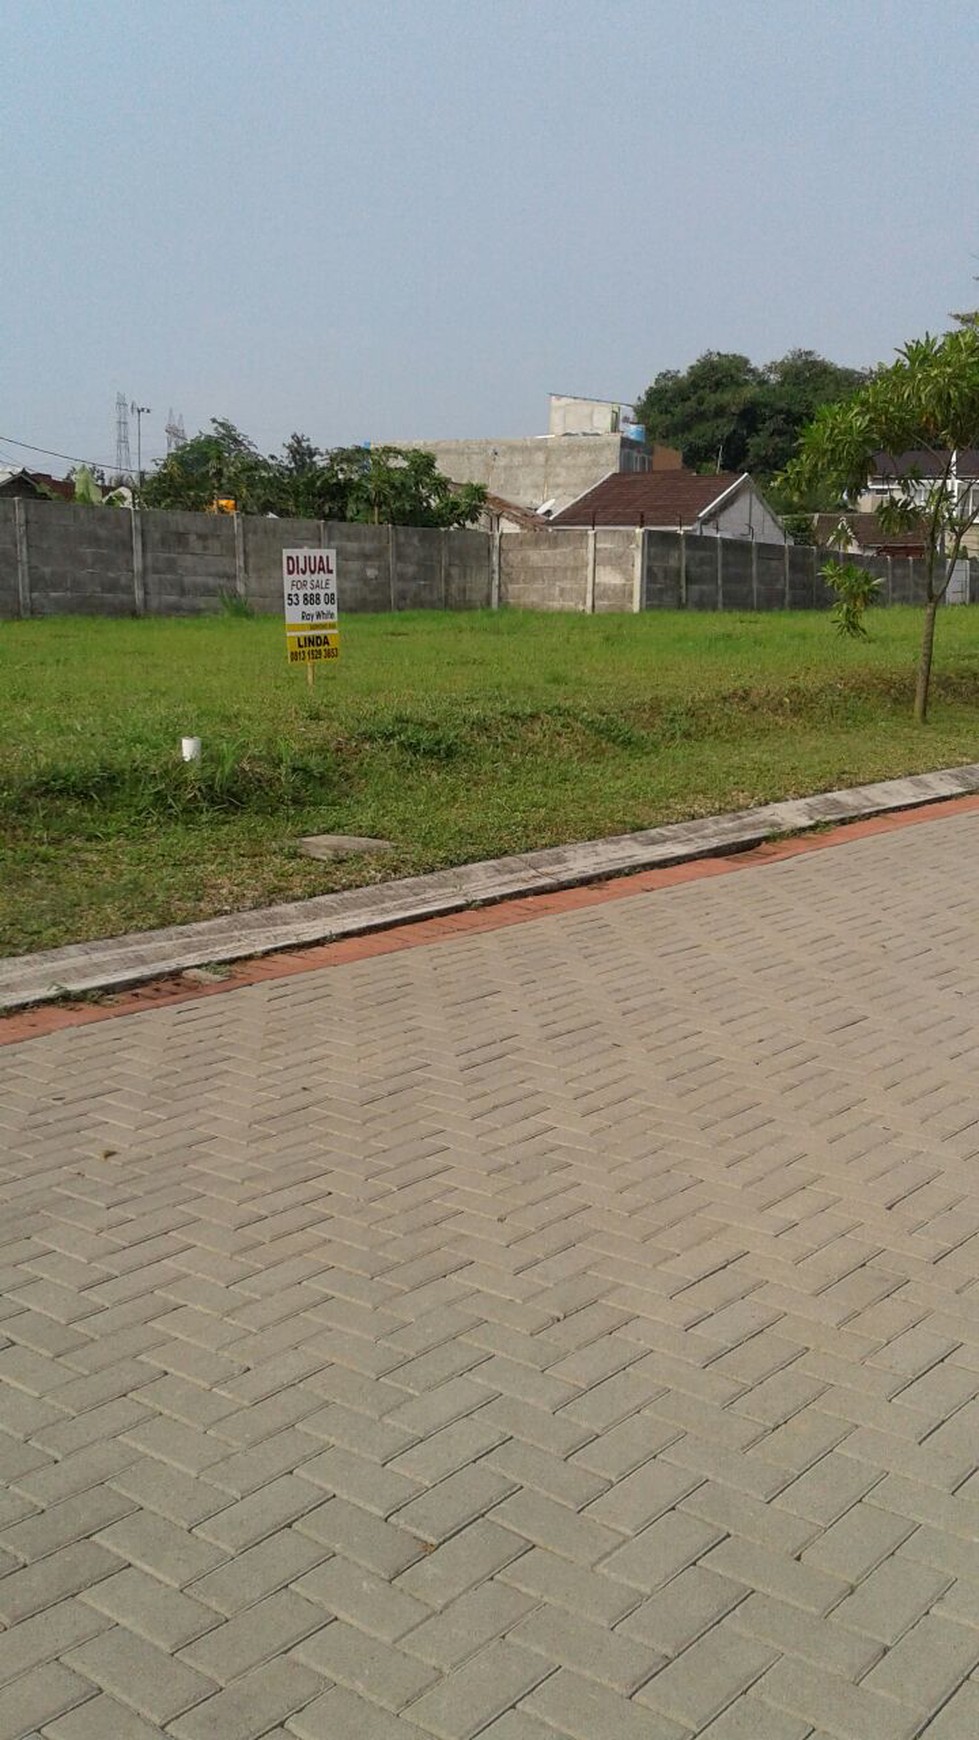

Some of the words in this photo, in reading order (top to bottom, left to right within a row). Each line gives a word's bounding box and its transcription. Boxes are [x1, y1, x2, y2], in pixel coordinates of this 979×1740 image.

[286, 555, 334, 576] DIJUAL
[291, 580, 308, 590] FOR
[309, 579, 331, 590] SALE
[287, 593, 300, 606] 53
[302, 593, 321, 605] 888
[323, 593, 336, 605] 08
[301, 611, 314, 622] Ray
[315, 610, 335, 620] White
[297, 635, 330, 648] LINDA
